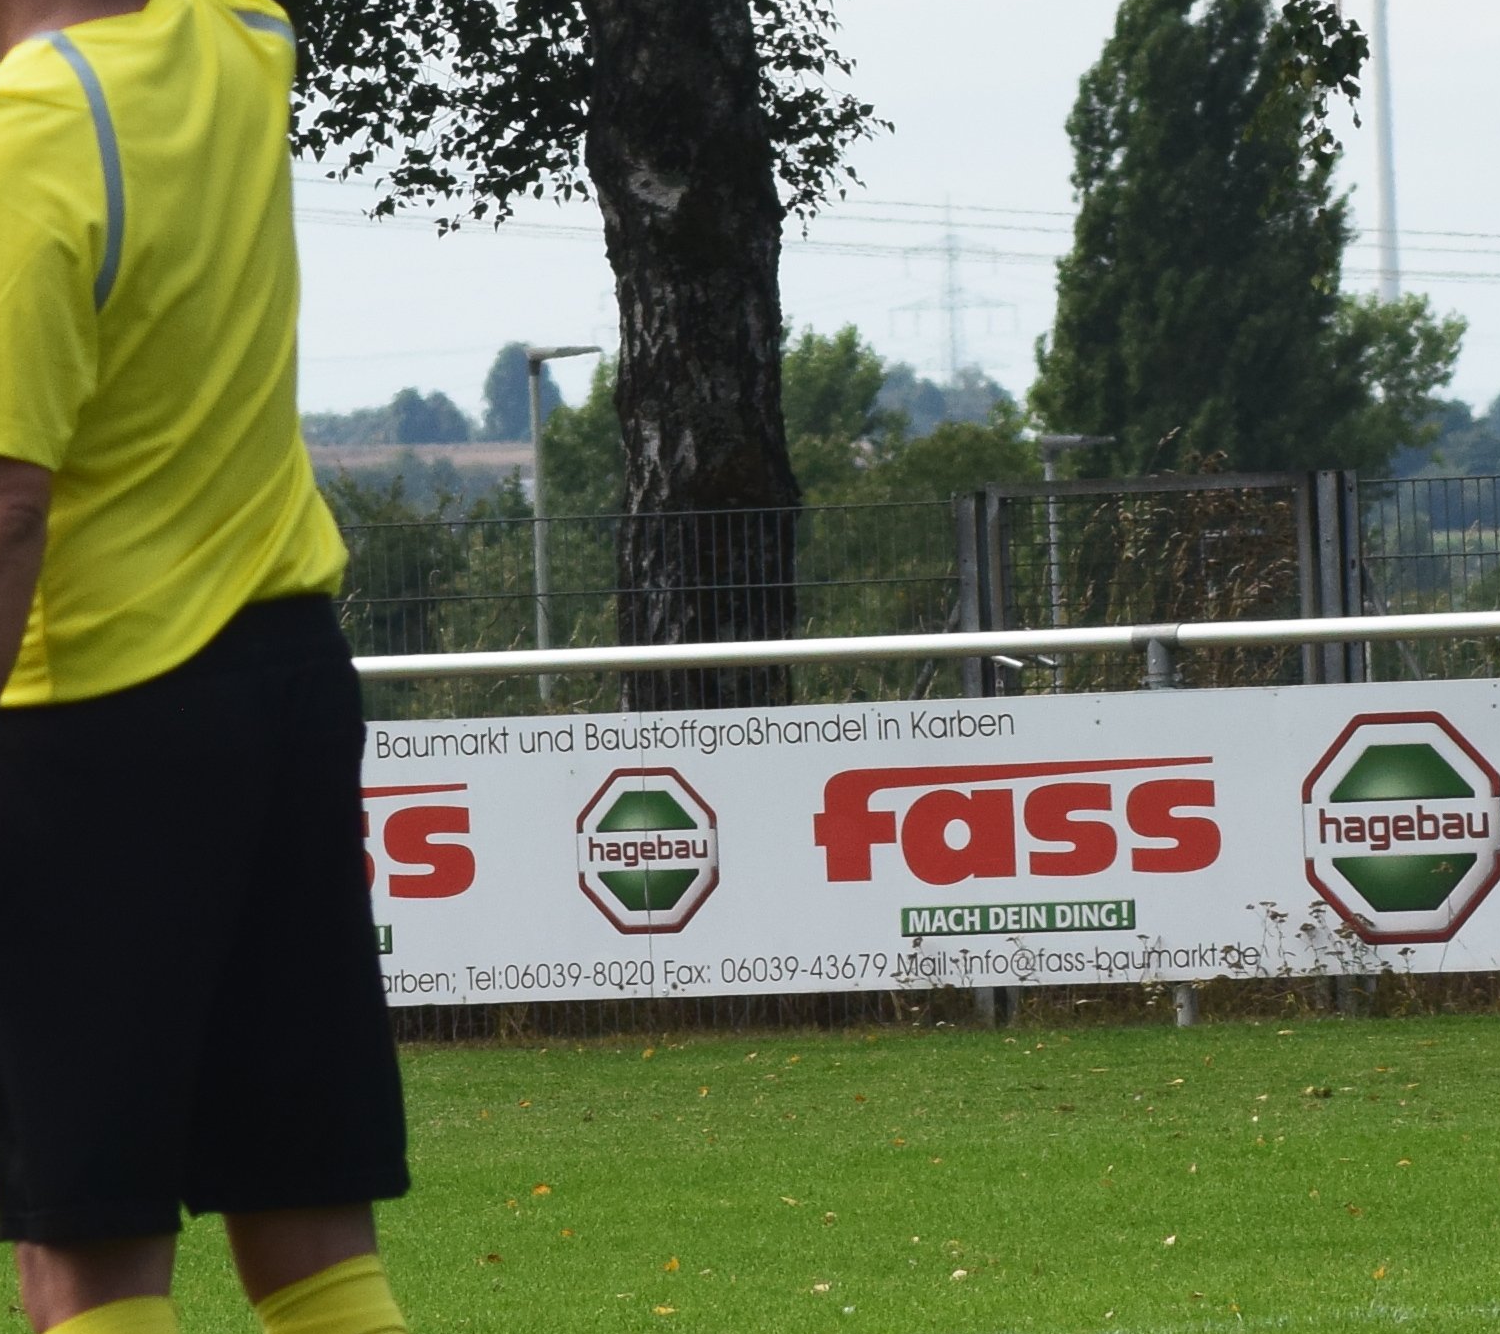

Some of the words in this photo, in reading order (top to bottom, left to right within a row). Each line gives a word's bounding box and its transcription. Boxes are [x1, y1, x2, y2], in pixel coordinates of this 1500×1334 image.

[376, 726, 509, 759] Baumarkt
[518, 724, 574, 755] und
[585, 713, 868, 755] Baustoffgroßhandel
[877, 713, 901, 741] in
[911, 709, 1016, 740] Karben
[814, 756, 1221, 886] fass
[1319, 806, 1490, 852] hagebau
[588, 835, 709, 866] hagebau
[908, 907, 982, 934] MACH
[989, 904, 1049, 931] DEIN
[1055, 900, 1130, 929] DING!
[380, 967, 458, 995] arben;
[664, 959, 712, 987] Fax:
[720, 953, 888, 984] 06039-43679
[896, 951, 954, 979] Mail:
[962, 943, 1261, 977] info@fass-baumarkt.de
